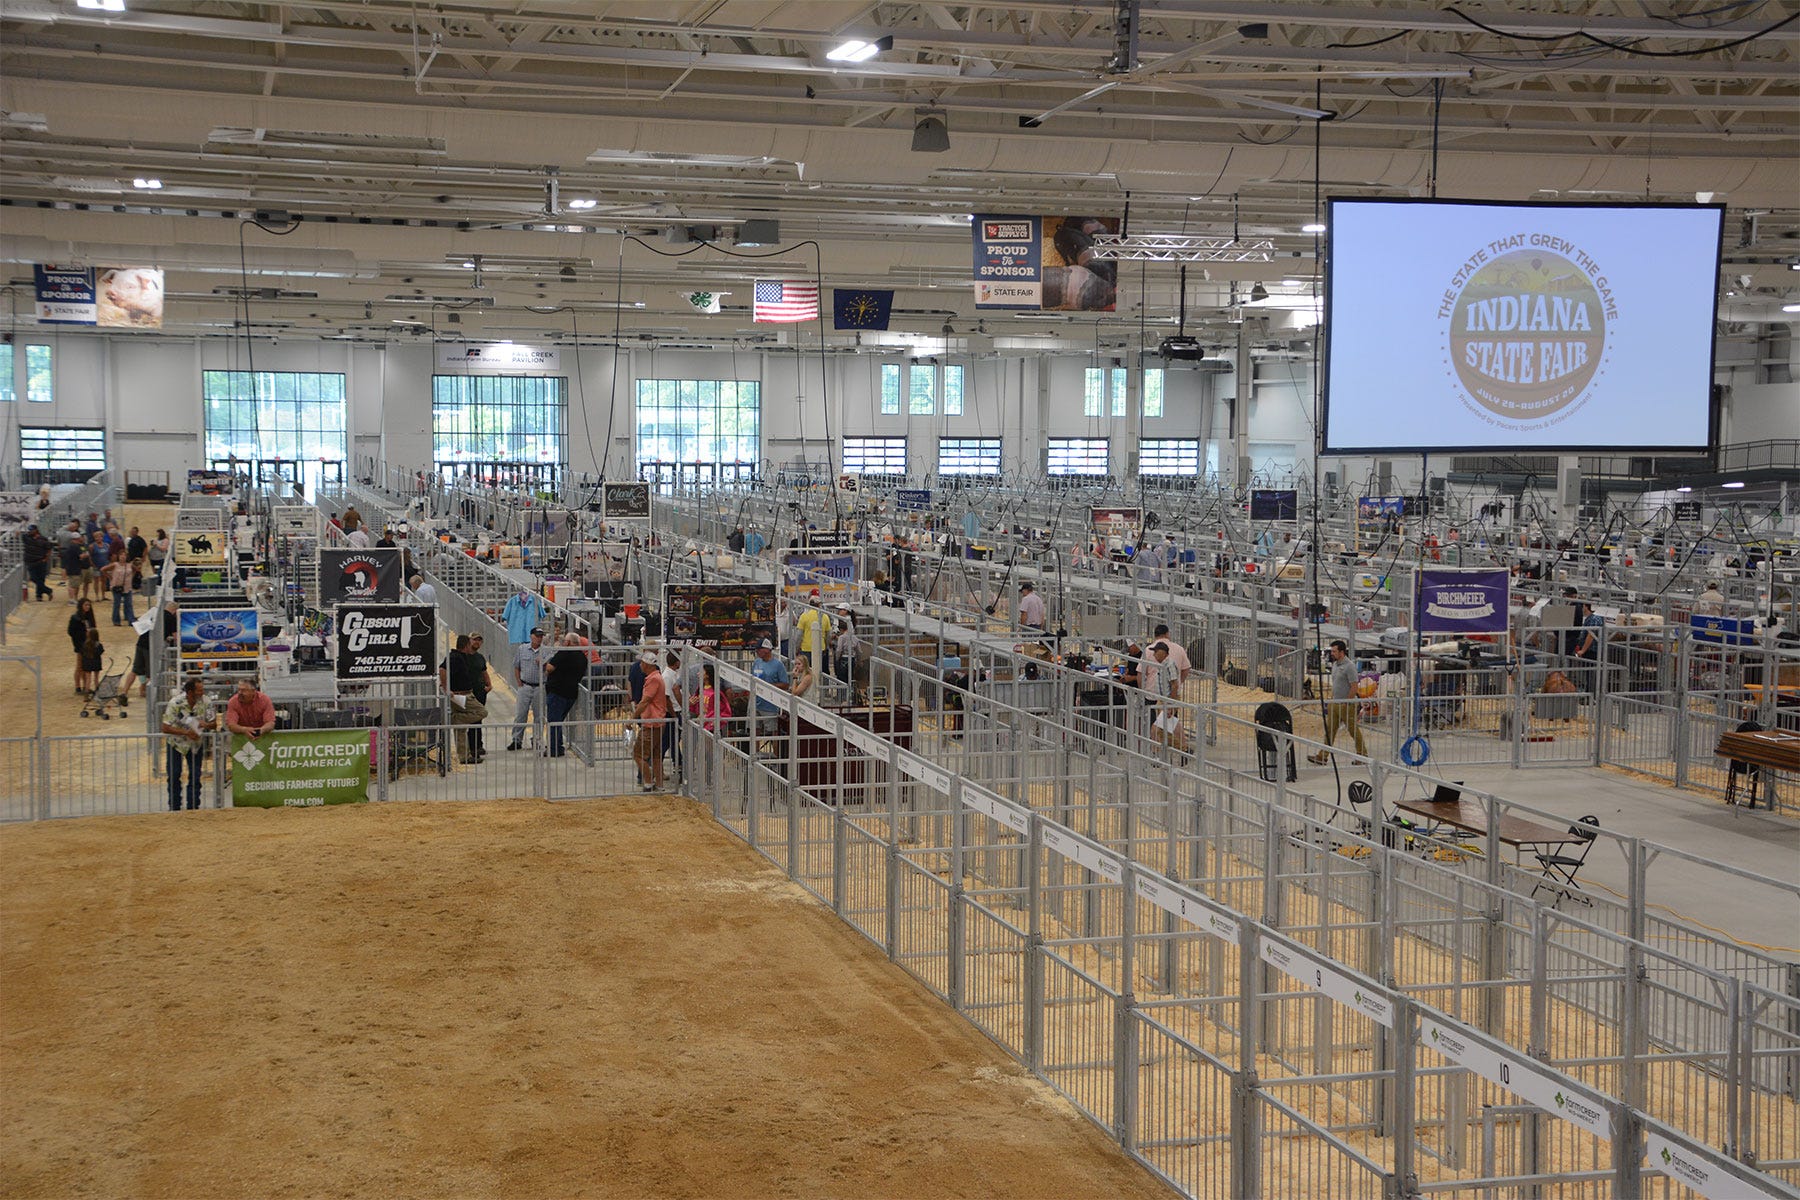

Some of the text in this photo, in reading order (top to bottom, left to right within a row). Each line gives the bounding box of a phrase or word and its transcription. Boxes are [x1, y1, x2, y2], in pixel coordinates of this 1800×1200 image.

[986, 246, 1028, 256] PROUD
[980, 266, 1034, 276] SPONSOR
[1438, 233, 1618, 322] THE STATE THAT GREW THE GAME
[48, 275, 84, 284] PROUD
[42, 290, 92, 300] SPONSOR
[994, 288, 1034, 296] STATE FAIR
[1466, 294, 1592, 332] INDIANA
[1465, 341, 1589, 384] STATE FAIR
[1476, 388, 1500, 404] JULY
[1562, 386, 1575, 398] 20
[1459, 393, 1487, 420] Presented
[1496, 420, 1518, 431] Pacers
[1520, 423, 1544, 432] Sports
[1550, 392, 1593, 426] Entertainment
[338, 555, 383, 569] HARVEY
[1436, 592, 1486, 606] BIRCHMEIER
[1436, 609, 1459, 617] SHOW
[342, 611, 402, 636] GIBSON
[348, 628, 398, 652] GIRLS
[694, 638, 718, 646] SMITH
[354, 655, 422, 665] 740.571.6226
[268, 740, 370, 764] farmCREDIT
[276, 758, 352, 769] MID-AMERICA
[244, 780, 285, 792] SECURING
[327, 777, 360, 788] FUTURES
[1316, 970, 1322, 988] 9
[1500, 1062, 1510, 1084] 10
[1565, 1096, 1600, 1122] farmCREDIT
[1672, 1152, 1709, 1182] farmCREDIT
